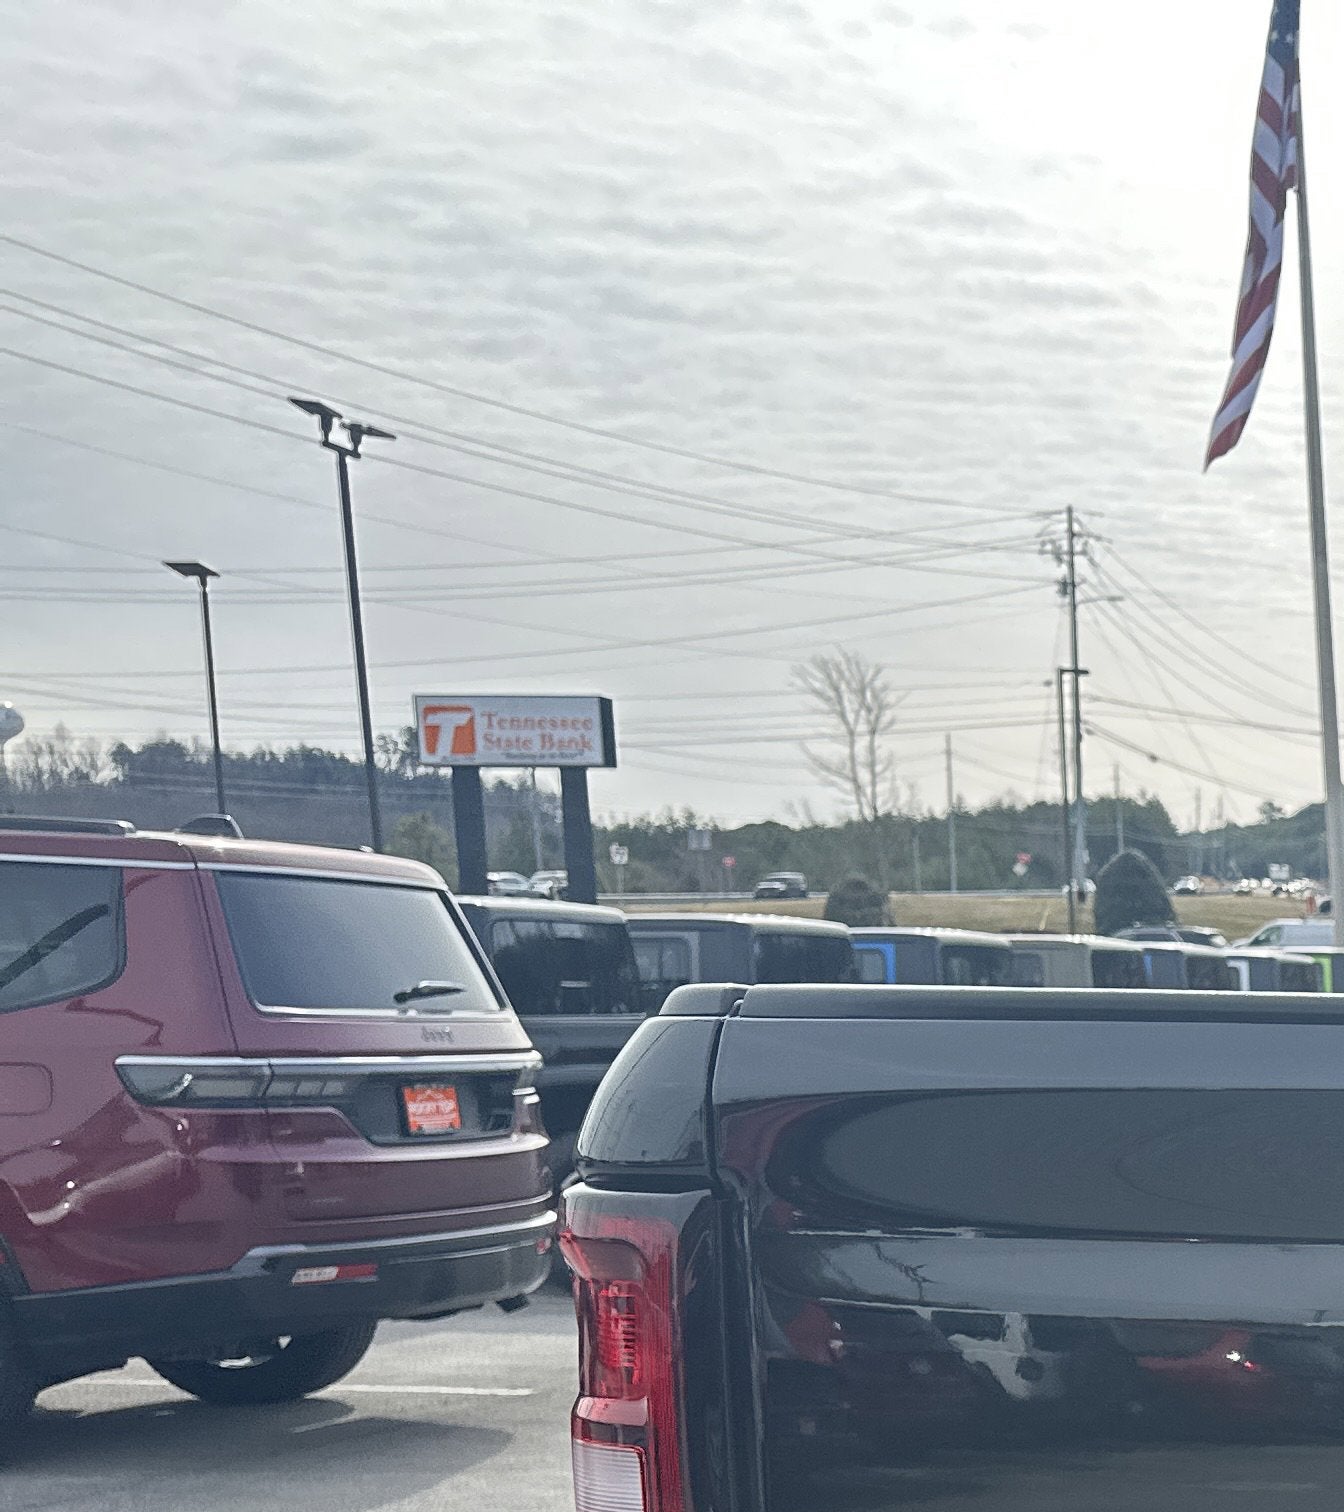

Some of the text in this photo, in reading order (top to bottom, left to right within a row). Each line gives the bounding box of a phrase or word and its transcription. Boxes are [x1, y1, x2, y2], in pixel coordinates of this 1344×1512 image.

[480, 711, 593, 732] Tennessee
[482, 732, 593, 752] State Bank
